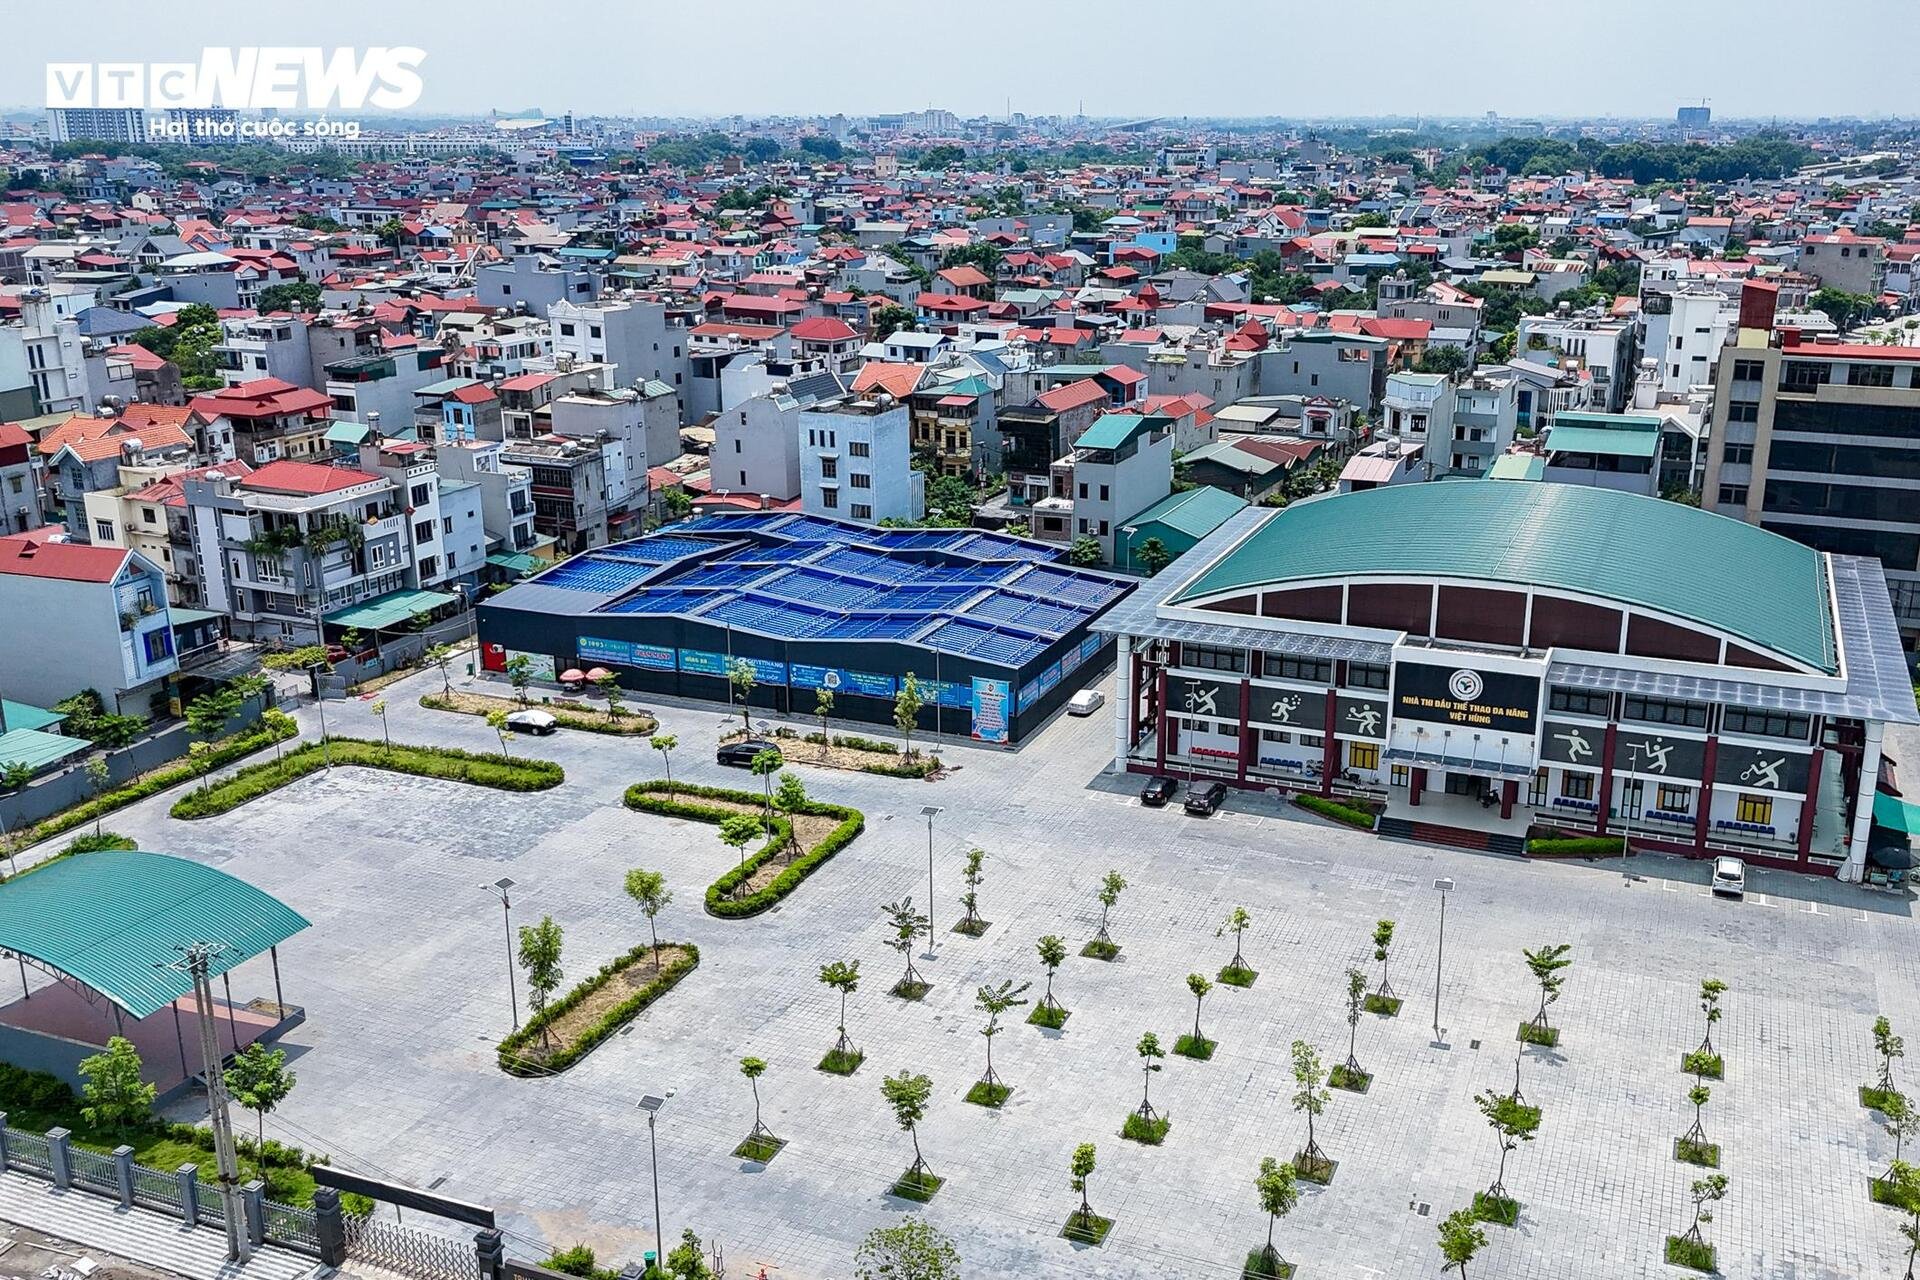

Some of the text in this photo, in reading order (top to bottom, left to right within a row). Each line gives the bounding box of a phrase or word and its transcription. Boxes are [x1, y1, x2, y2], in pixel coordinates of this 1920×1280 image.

[1402, 696, 1419, 705] NHÀ
[1421, 698, 1433, 706] THI
[1434, 699, 1451, 709] ĐẤU
[1470, 704, 1491, 714] THAO
[1492, 706, 1504, 715] ĐA
[1506, 708, 1529, 719] NĂNG
[1449, 711, 1467, 722] VIỆT
